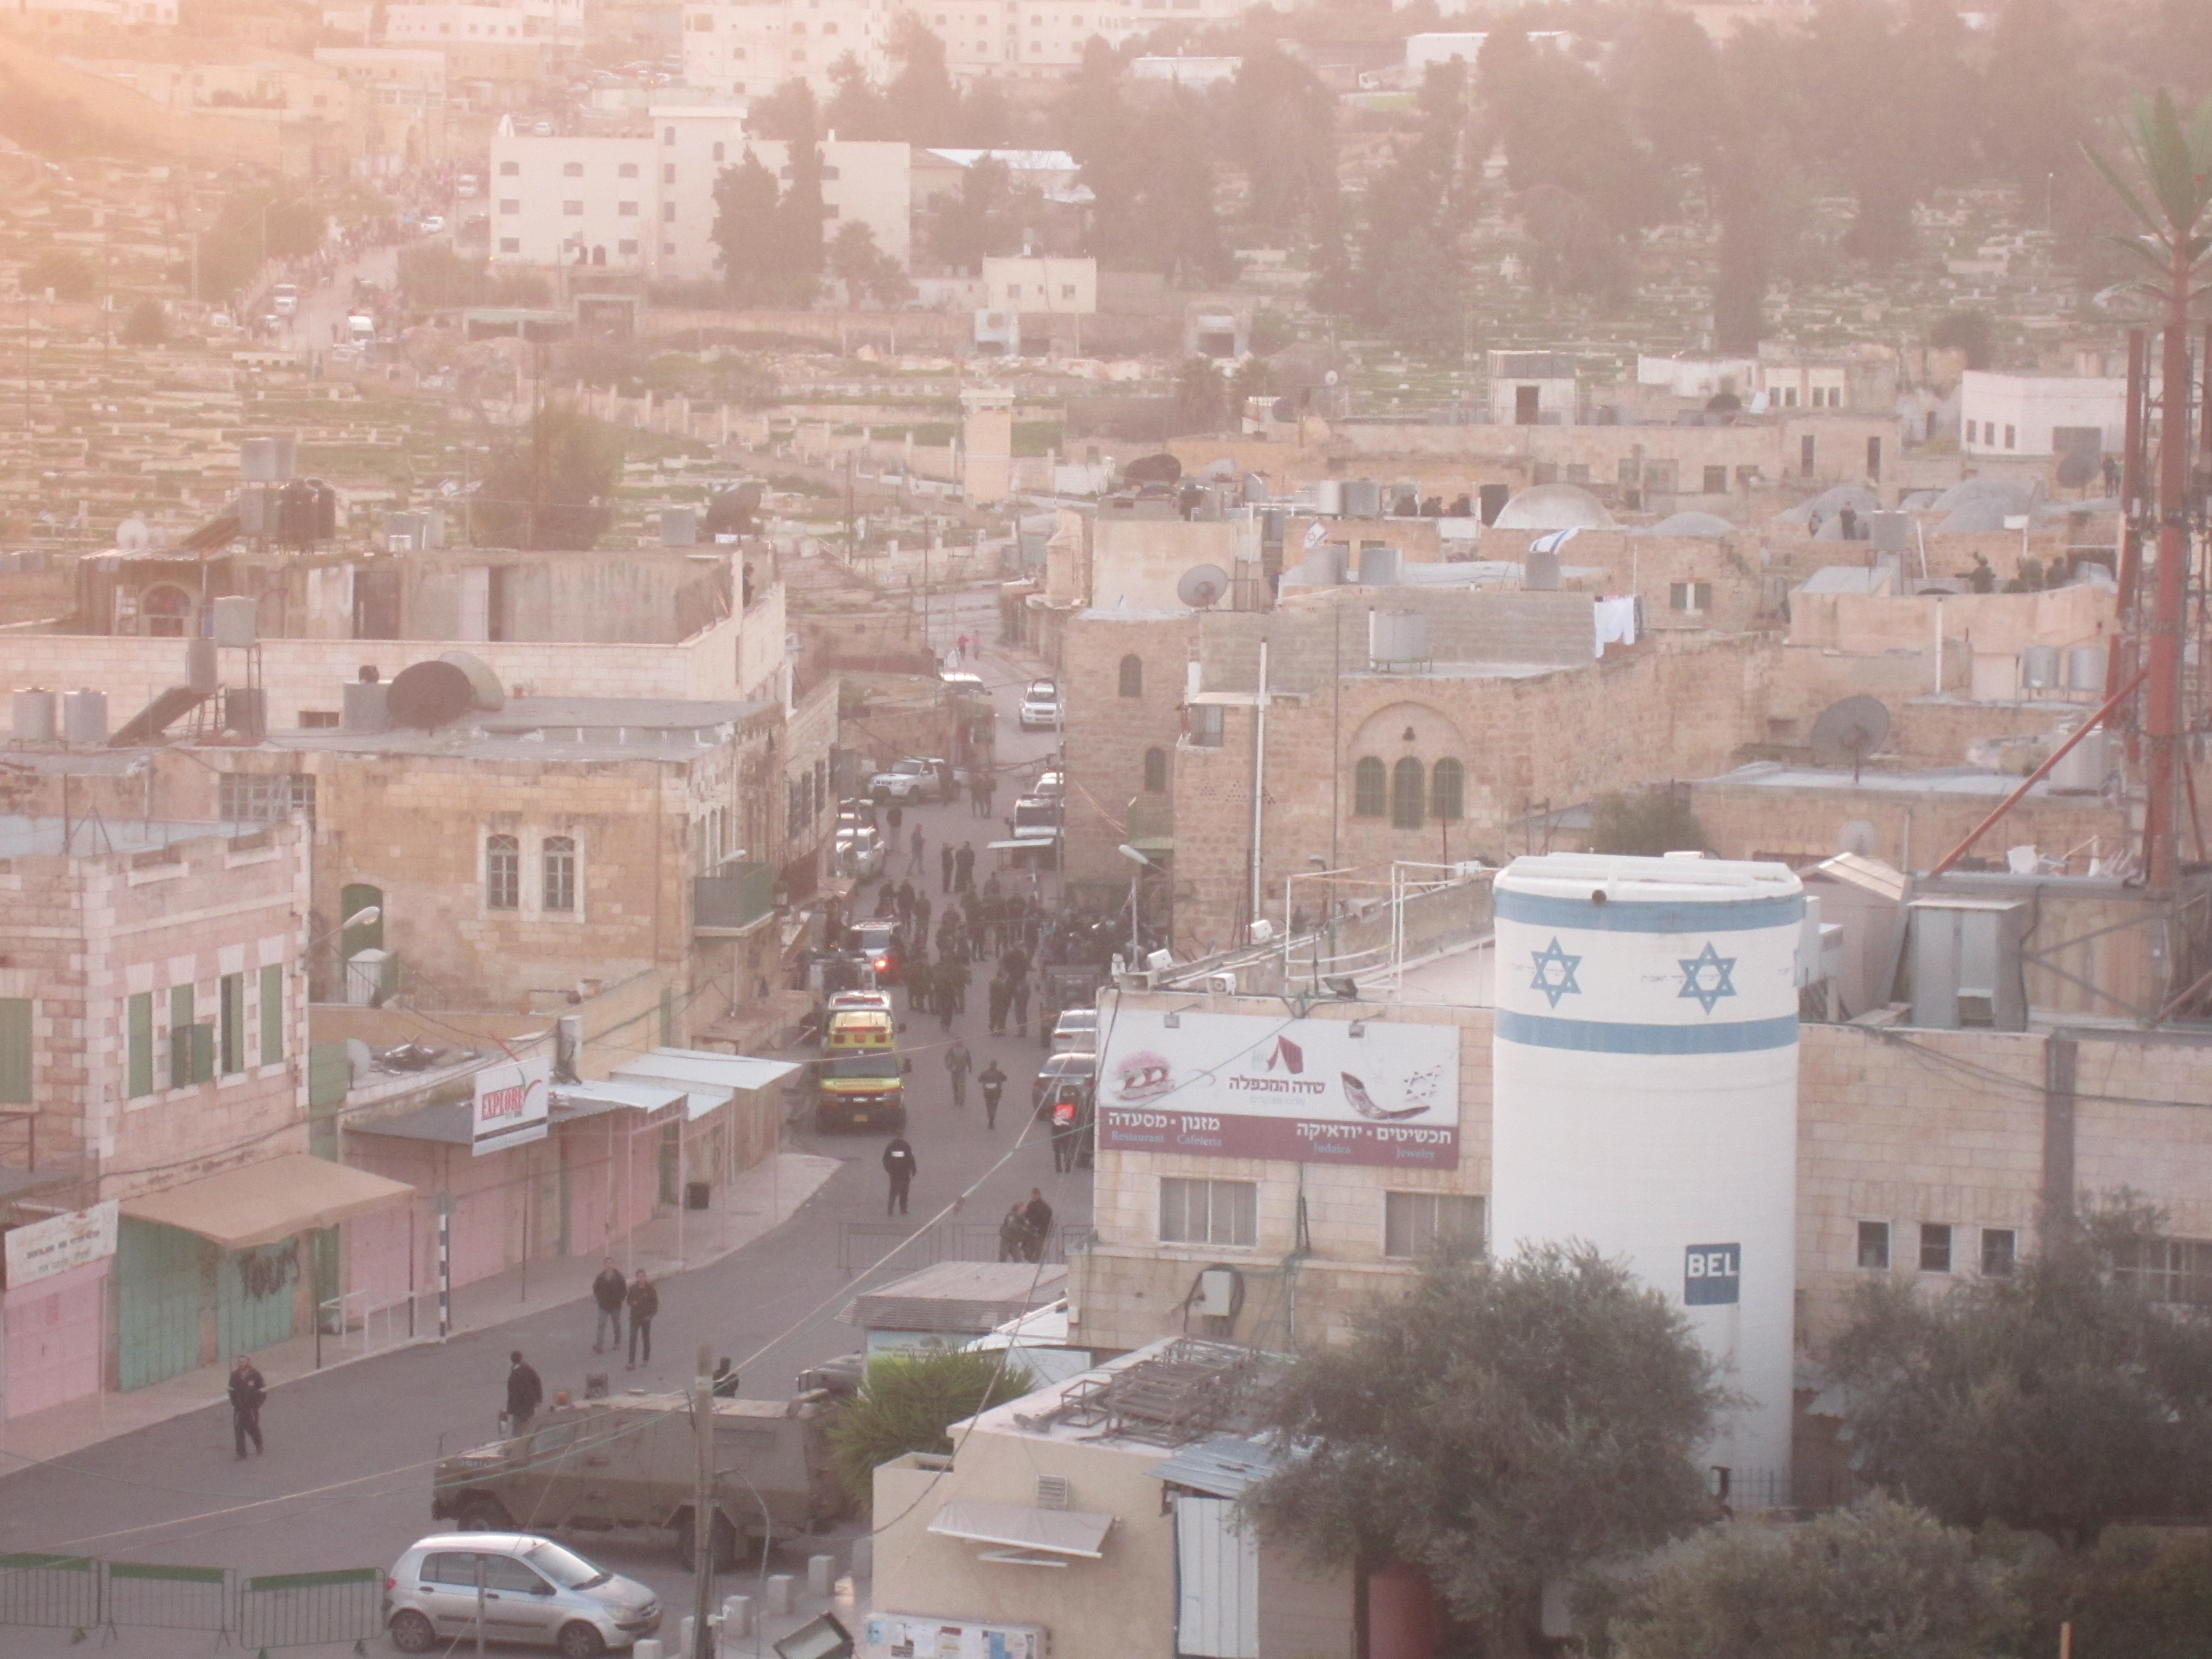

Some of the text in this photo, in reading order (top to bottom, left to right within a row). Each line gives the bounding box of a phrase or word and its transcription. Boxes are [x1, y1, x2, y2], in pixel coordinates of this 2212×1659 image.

[1229, 1074, 1325, 1094] שדה המכפלה
[1109, 1111, 1220, 1134] מזנון מסעדה
[1110, 1130, 1164, 1144] Restaurant
[1177, 1134, 1222, 1147] Cafeteria
[1296, 1123, 1451, 1144] תכשיטים יודאיקה
[1688, 1253, 1739, 1277] BEL
